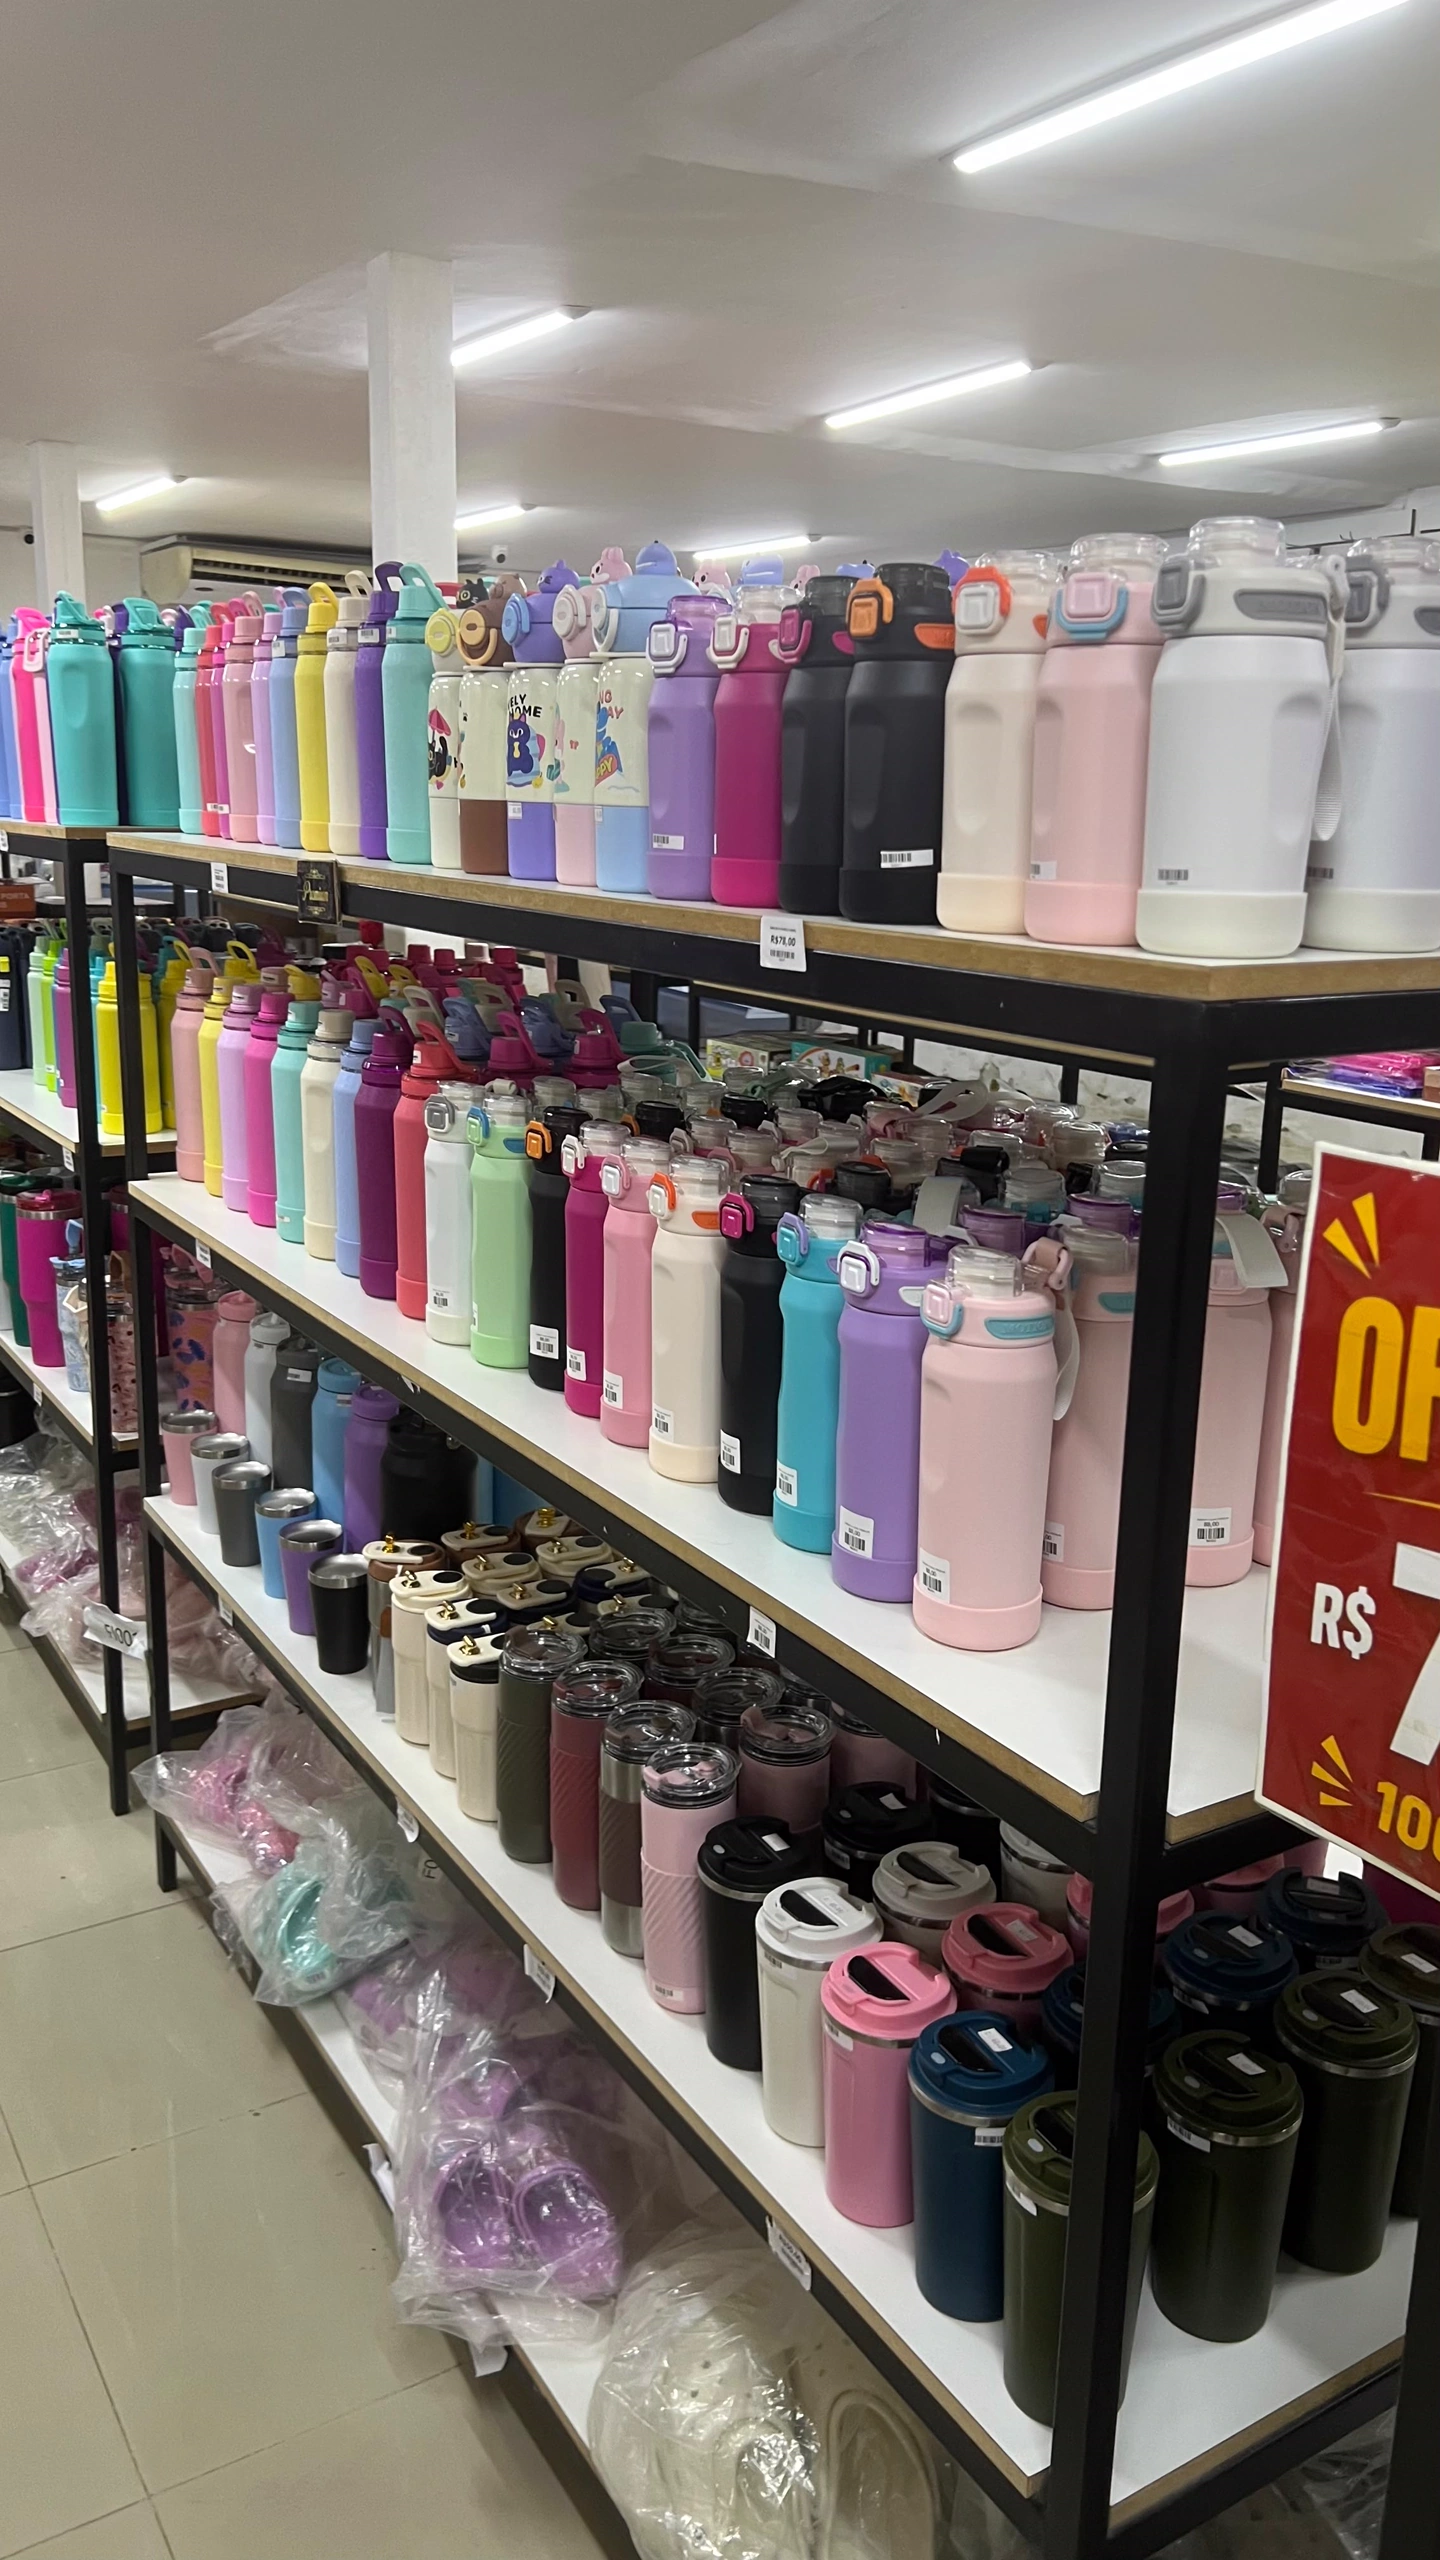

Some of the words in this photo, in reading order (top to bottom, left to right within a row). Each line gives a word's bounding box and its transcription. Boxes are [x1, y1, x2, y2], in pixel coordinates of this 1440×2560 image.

[508, 694, 526, 707] ELY
[1310, 1582, 1376, 1660] R$
[1377, 1781, 1440, 1863] 10
